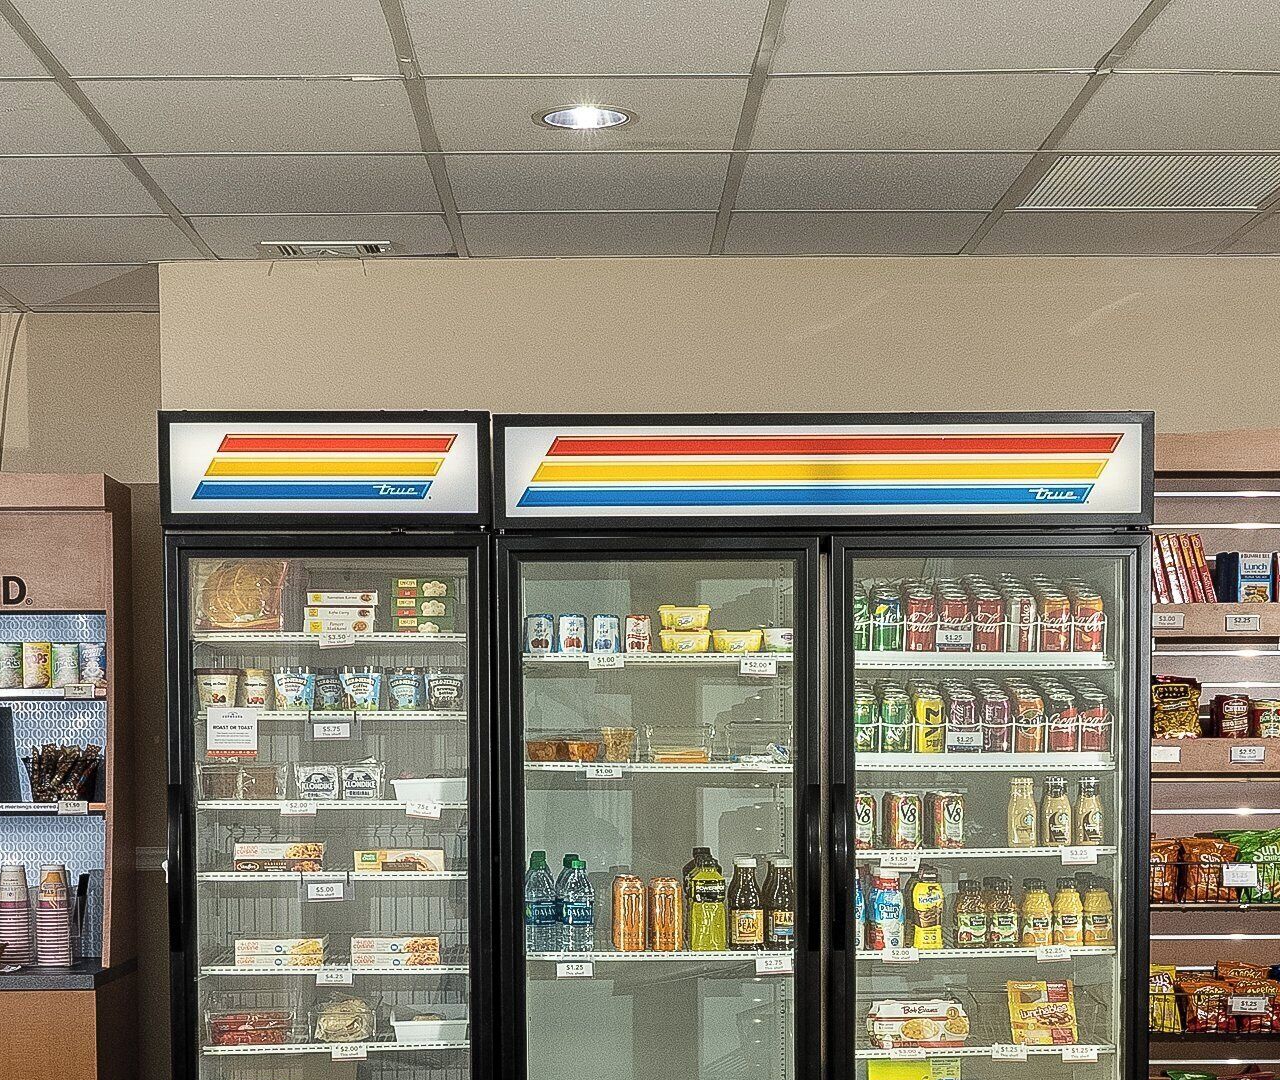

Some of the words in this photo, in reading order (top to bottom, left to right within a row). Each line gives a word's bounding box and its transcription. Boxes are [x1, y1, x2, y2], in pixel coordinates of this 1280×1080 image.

[1243, 562, 1268, 571] Lunch
[345, 780, 376, 789] KLONDIKE
[856, 804, 871, 823] V8
[901, 804, 917, 822] V8
[945, 803, 961, 822] V8
[775, 913, 793, 923] PEAK
[737, 919, 756, 929] PEAK
